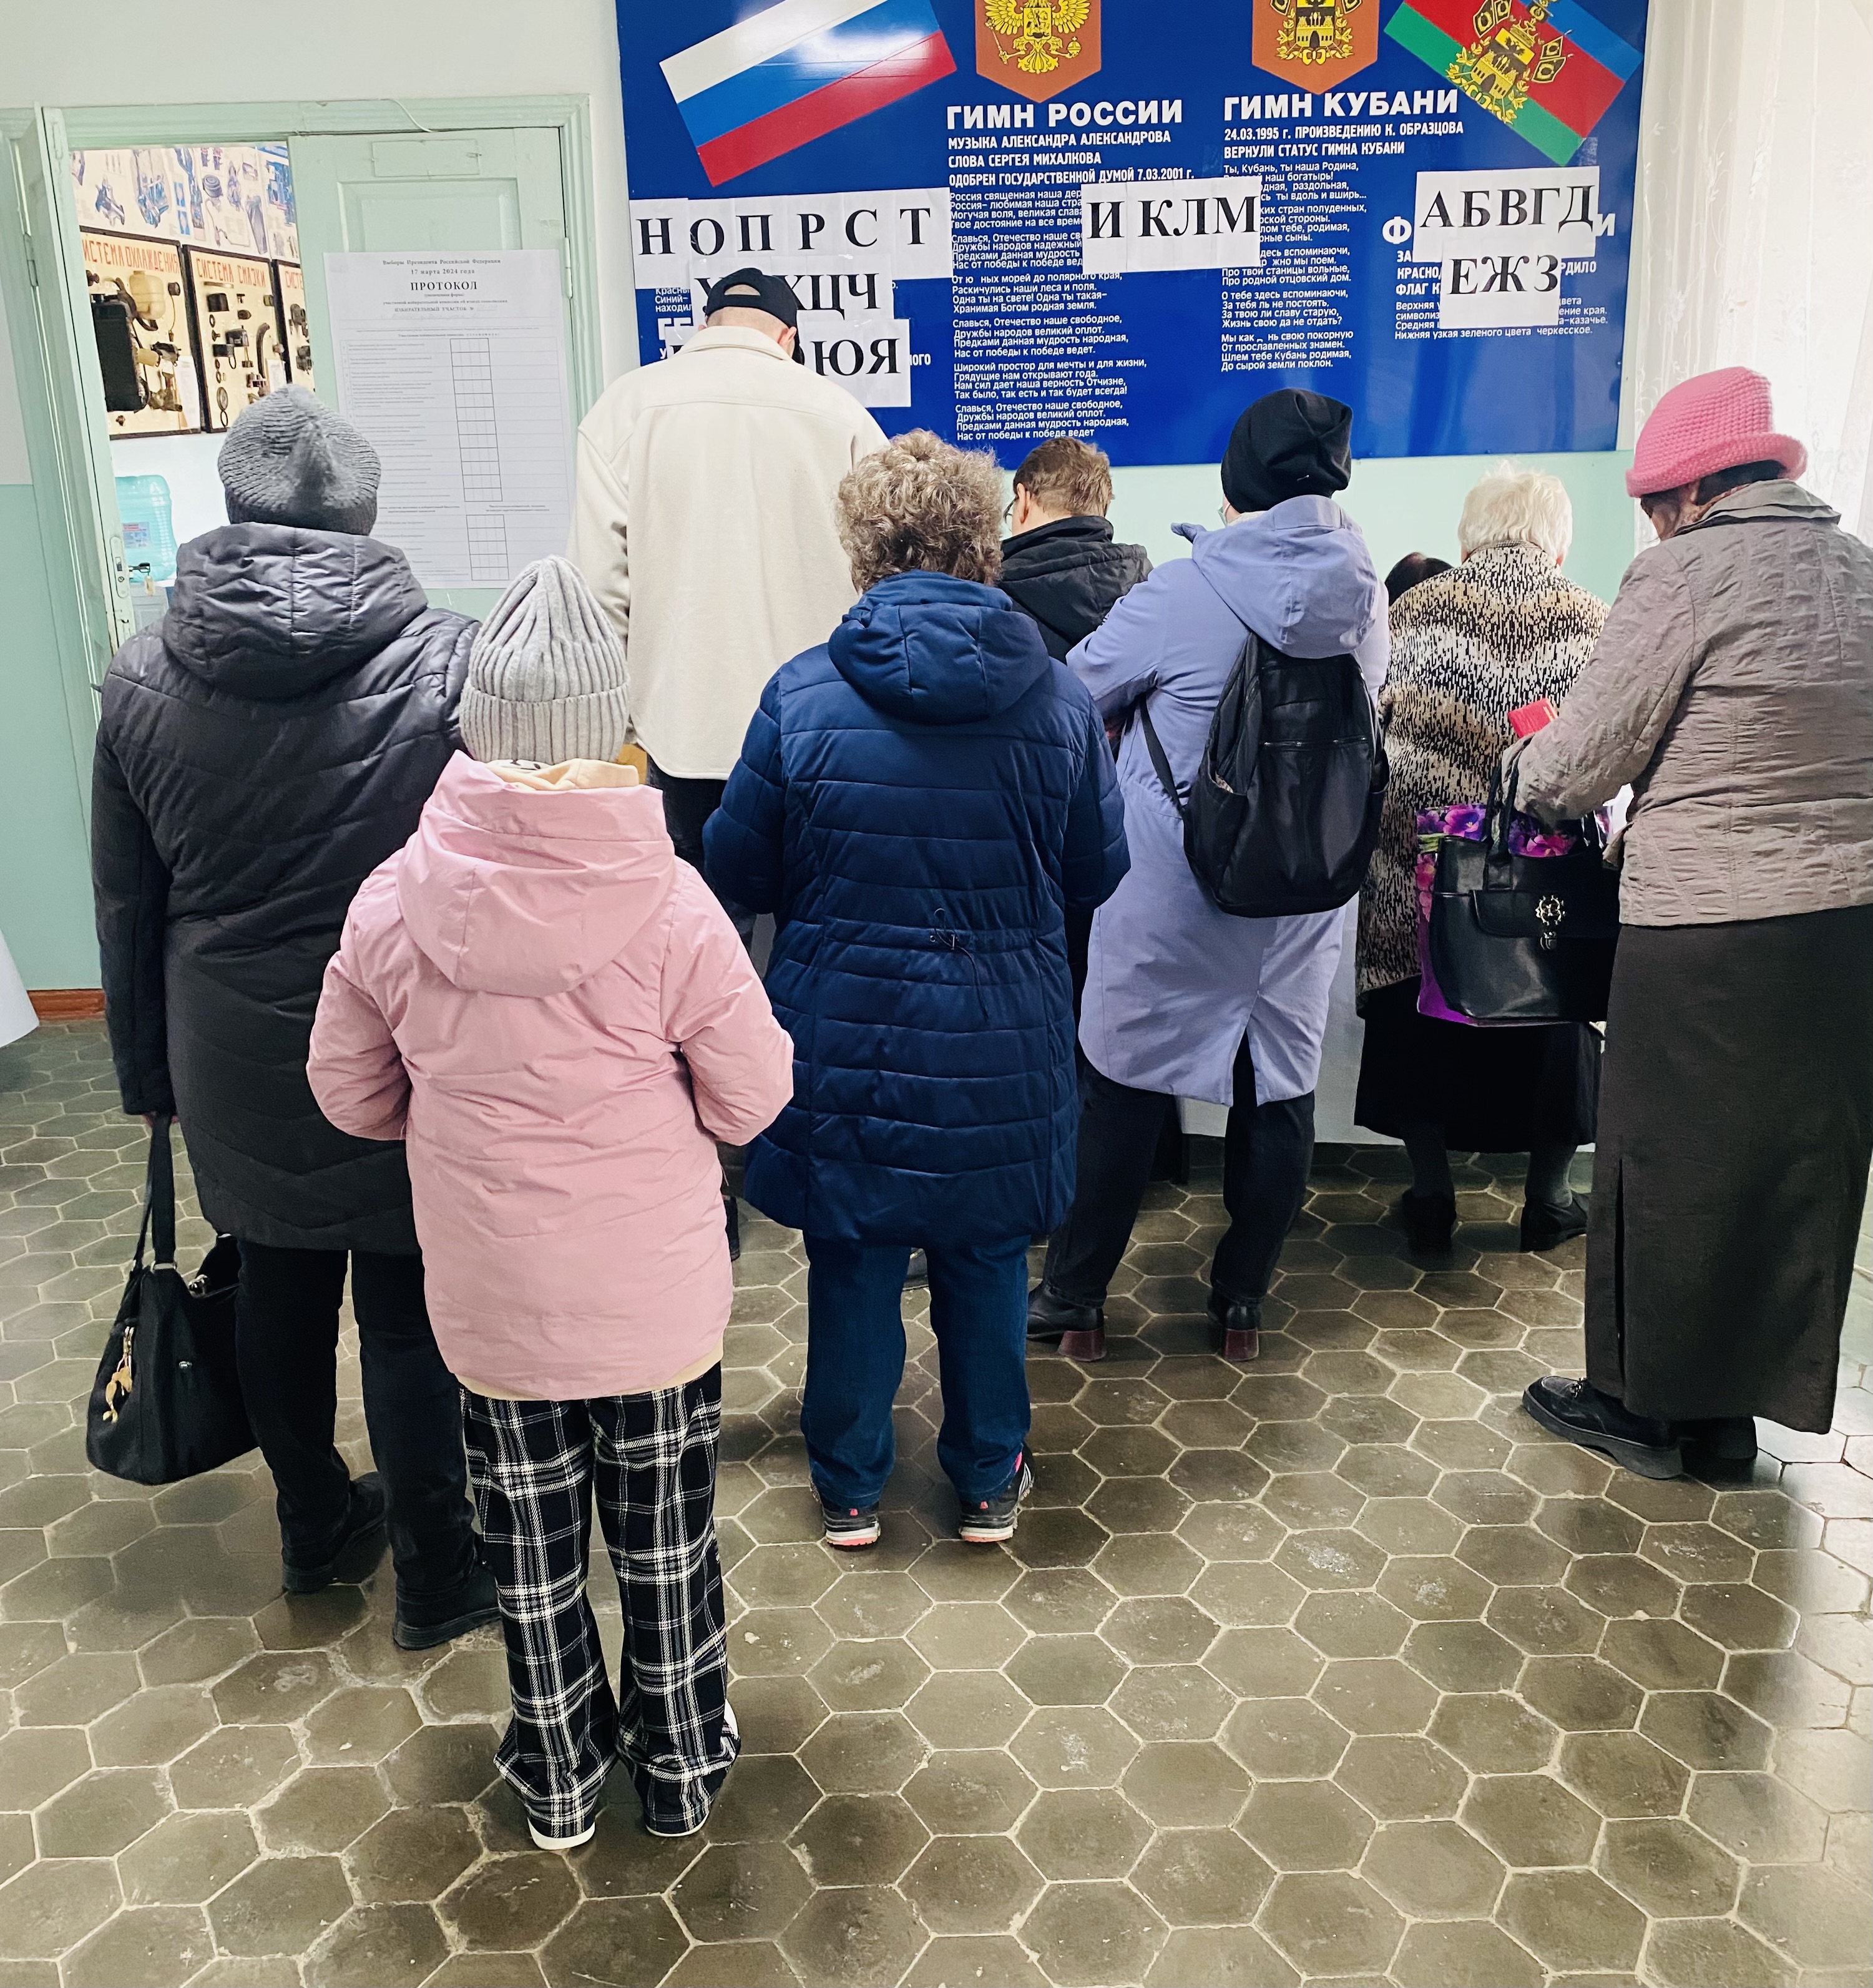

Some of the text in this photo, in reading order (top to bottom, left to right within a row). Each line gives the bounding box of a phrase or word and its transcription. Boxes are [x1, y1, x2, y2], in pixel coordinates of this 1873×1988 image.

[1224, 89, 1457, 120] ГИМН КУБАНИ
[947, 100, 1182, 129] ГИМН РОССИИ
[1224, 121, 1464, 140] 24.03.1995 г. ПРОИЗВЕДЕНИЮ К. ОБРАЗЦОВА
[948, 130, 1171, 149] МУЗЫКА АЛЕКСАНДРА АЛЕКСАНДРОВА
[1224, 142, 1405, 158] ВЕРНУЛИ СТАТУС ГИМНА КУБАНИ
[948, 151, 1102, 167] СЛОВА СЕРГЕЯ МИХАЛКОВА
[1224, 165, 1239, 174] Ты,
[1241, 164, 1278, 174] Кубань,
[1322, 162, 1359, 172] Родина,
[949, 166, 1195, 189] ОДОБРЕН ГОСУДАРСТВЕННОЙ ДУМОЙ 7.03.2001 г.
[950, 192, 982, 201] Россия
[984, 192, 1035, 201] священная
[1086, 200, 1125, 239] И
[636, 207, 931, 255] Н О П Р С Т
[82, 240, 180, 274] ИСТЕМА ОХЛАЖДЕНИЯ
[196, 258, 266, 288] СИСТЕМА СМАЗКИ
[1221, 268, 1240, 278] Про
[1265, 267, 1306, 275] станицы
[411, 281, 477, 291] ПРОТОКОЛ
[1222, 274, 1351, 287] Про родной отцовский дом.
[1221, 290, 1348, 300] О тебе здесь вспоминаючи,
[1396, 283, 1429, 295] ФЛАГ
[952, 296, 976, 305] Одна
[1005, 293, 1034, 302] свете!
[1035, 293, 1060, 302] Одна
[1222, 301, 1233, 310] За
[1235, 301, 1256, 309] тебя
[1285, 300, 1329, 308] постоять.
[953, 305, 999, 315] Хранимая
[1000, 303, 1029, 311] Богом
[1031, 303, 1065, 313] родная
[1396, 301, 1434, 311] Верхняя
[1583, 306, 1607, 315] края.
[1221, 310, 1233, 318] За
[1274, 310, 1301, 318] славу
[1303, 308, 1339, 318] старую,
[1222, 320, 1251, 328] Жизнь
[1279, 319, 1291, 328] да
[1306, 316, 1342, 326] отдать?
[1395, 321, 1434, 330] Средняя
[1394, 331, 1430, 340] Нижняя
[1432, 331, 1459, 340] узкая
[1504, 328, 1532, 337] цвета
[1536, 327, 1593, 336] черкесское.
[1221, 343, 1233, 351] От
[1235, 342, 1308, 353] прославленных
[1221, 351, 1351, 361] Шлем тебе Кубань родимая,
[954, 363, 995, 373] Широкий
[997, 363, 1035, 372] простор
[1037, 362, 1055, 371] для
[1096, 361, 1113, 369] для
[1115, 360, 1147, 368] жизни,
[1221, 362, 1234, 371] До
[1235, 361, 1265, 371] сырой
[954, 372, 1000, 381] Грядущие
[1022, 371, 1073, 380] открывают
[954, 381, 972, 389] Нам
[992, 381, 1014, 390] дает
[1042, 379, 1084, 389] верность
[1086, 378, 1126, 386] Отчизне,
[956, 391, 971, 399] Так
[972, 390, 999, 399] было,
[1065, 388, 1093, 398] будет
[1095, 386, 1127, 396] всегда!
